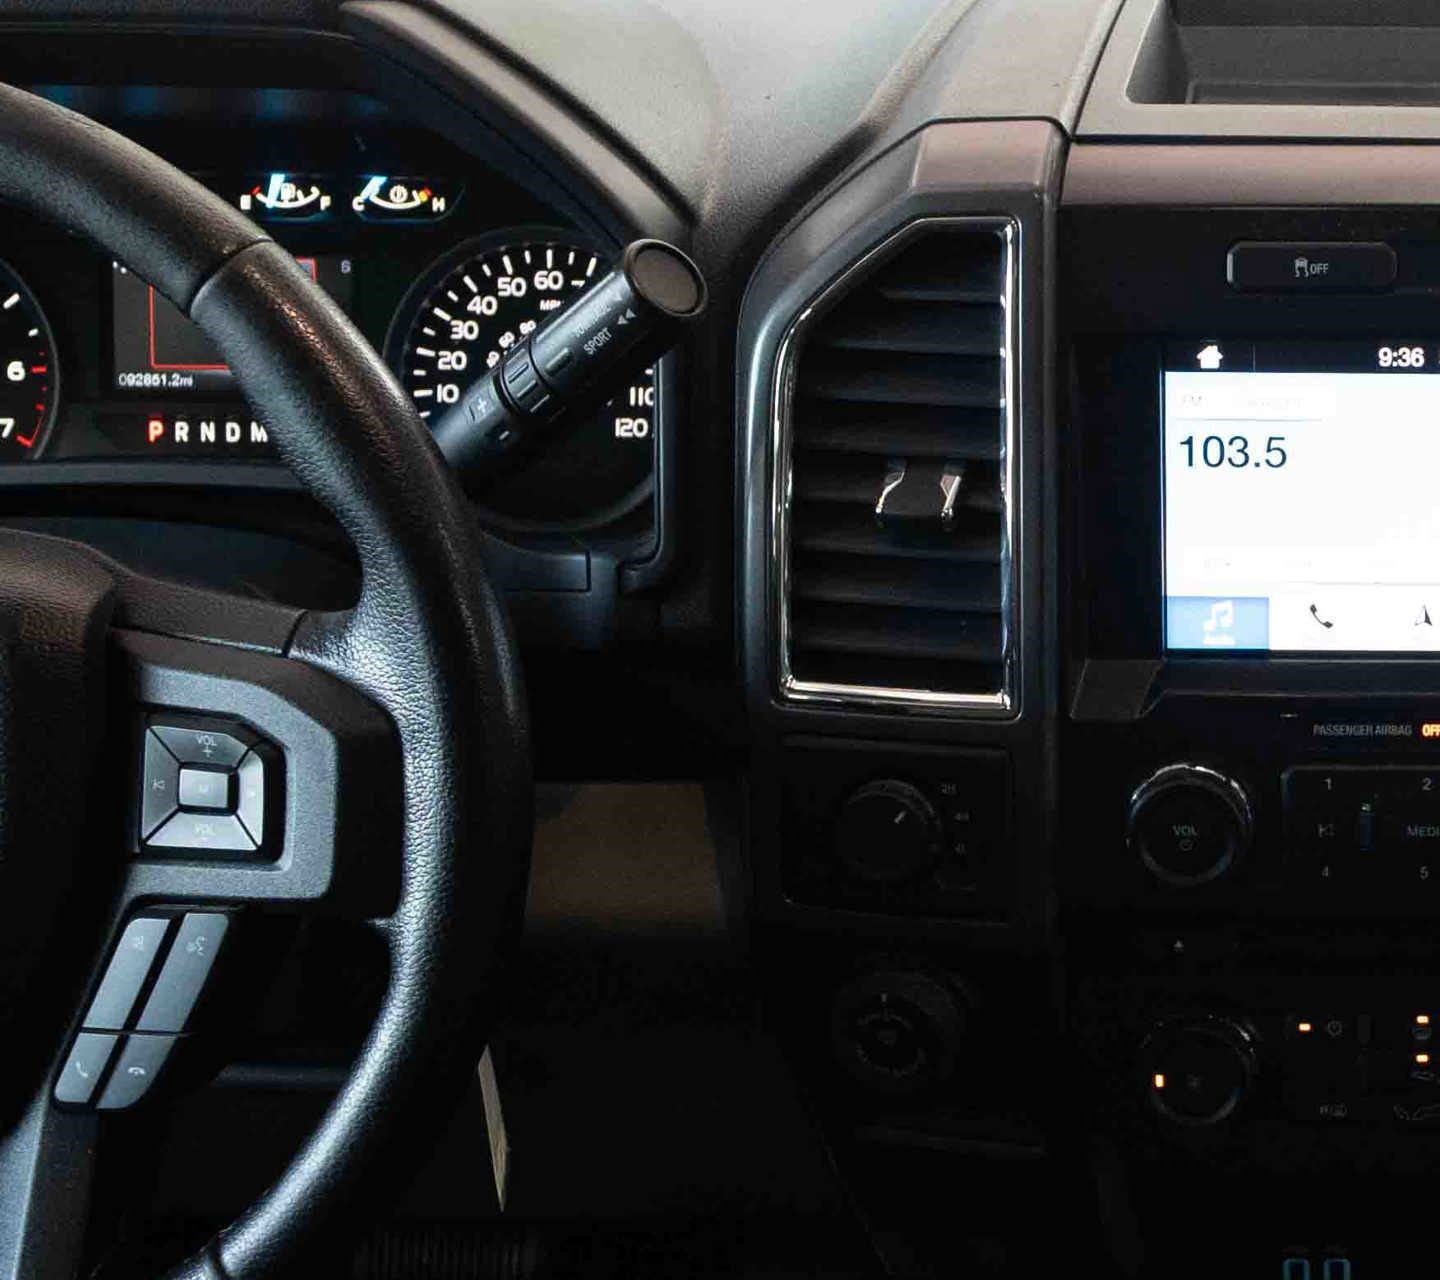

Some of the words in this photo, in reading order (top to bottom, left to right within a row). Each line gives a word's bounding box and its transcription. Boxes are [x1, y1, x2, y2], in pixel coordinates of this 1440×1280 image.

[320, 195, 331, 211] F
[352, 196, 365, 211] C
[432, 197, 445, 212] H
[1310, 262, 1329, 276] OFF
[497, 276, 526, 297] 50
[534, 271, 563, 290] 60
[467, 295, 497, 315] 40
[450, 320, 478, 340] 30
[583, 327, 612, 355] SPORT
[437, 350, 467, 370] 20
[1378, 346, 1424, 369] 9:36
[6, 360, 25, 381] 6
[436, 385, 459, 403] 10
[148, 421, 165, 443] P
[174, 422, 189, 443] R
[200, 422, 215, 443] N
[226, 422, 240, 443] D
[251, 423, 268, 443] M
[614, 418, 648, 438] 120
[1178, 436, 1287, 468] 103.5
[1313, 723, 1372, 738] PASSENGER
[1375, 723, 1412, 737] AIRBAG
[196, 735, 217, 746] VOL
[1422, 777, 1432, 791] 2
[1173, 824, 1198, 837] VOL
[1322, 866, 1330, 878] 4
[1420, 866, 1429, 879] 5
